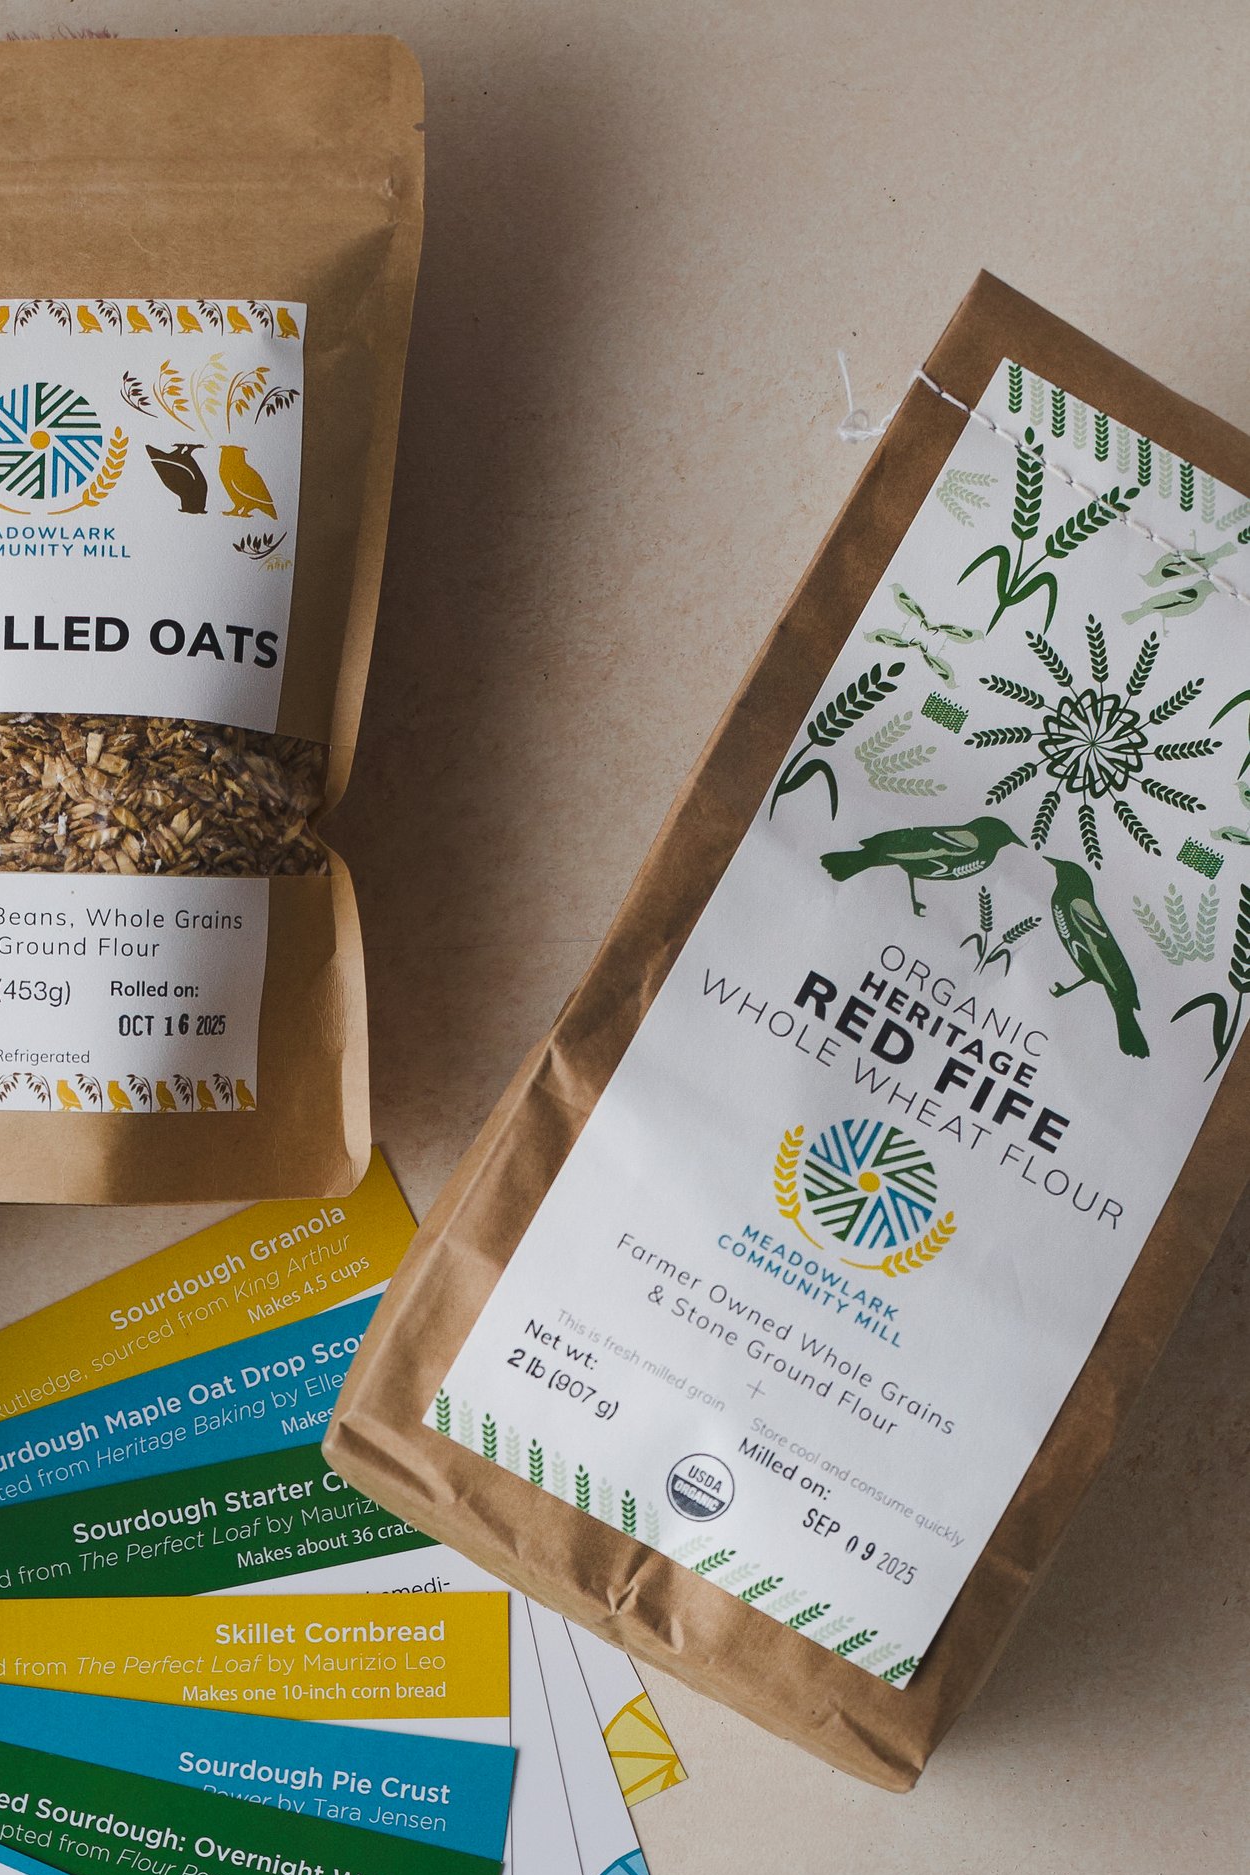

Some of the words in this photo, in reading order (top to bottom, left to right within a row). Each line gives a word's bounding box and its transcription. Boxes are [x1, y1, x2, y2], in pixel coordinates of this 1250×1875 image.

[84, 544, 131, 558] MILL
[150, 619, 278, 668] OATS
[86, 908, 164, 928] Whole
[175, 910, 242, 929] Grains
[99, 937, 160, 956] Flour
[111, 980, 168, 997] Rolled
[174, 986, 198, 997] on:
[881, 945, 1048, 1056] ORGANIC
[119, 1014, 154, 1036] OCT
[196, 1015, 226, 1036] 2025
[861, 971, 1037, 1086] HERITAGE
[797, 972, 914, 1065] RED
[934, 1057, 1070, 1154] FIFE
[703, 968, 842, 1067] WHOLE
[855, 1057, 992, 1150] WHEAT
[1000, 1143, 1124, 1230] FLOUR
[110, 1254, 246, 1330] Sourdough
[249, 1208, 346, 1261] Granola
[247, 1291, 301, 1324] Makes
[303, 1273, 327, 1295] 4.5
[330, 1256, 370, 1284] cups
[718, 1234, 850, 1314] COMMUNITY
[854, 1311, 900, 1348] MILL
[742, 1224, 899, 1321] MEADOWLARK
[104, 1396, 182, 1434] Maple
[188, 1376, 237, 1405] Oat
[240, 1355, 305, 1389] Drop
[73, 1497, 217, 1543] Sourdough
[224, 1480, 312, 1512] Starter
[803, 1508, 840, 1537] SEP
[876, 1552, 918, 1585] 2025
[215, 1623, 297, 1646] Skillet
[304, 1619, 445, 1644] Cornbread
[14, 1656, 67, 1677] from
[77, 1656, 117, 1675] The
[123, 1654, 205, 1675] Perfect
[211, 1653, 263, 1675] Loaf
[267, 1652, 295, 1678] by
[303, 1652, 398, 1672] Maurizio
[404, 1652, 446, 1671] Leo
[182, 1684, 239, 1702] Makes
[242, 1687, 277, 1702] one
[282, 1682, 347, 1701] 10-inch
[351, 1686, 392, 1700] corn
[395, 1681, 447, 1699] bread
[178, 1752, 323, 1790] Sourdough
[332, 1770, 372, 1794] Pie
[381, 1777, 451, 1804] Crust
[35, 1798, 186, 1852] Sourdough:
[58, 1833, 113, 1863] from
